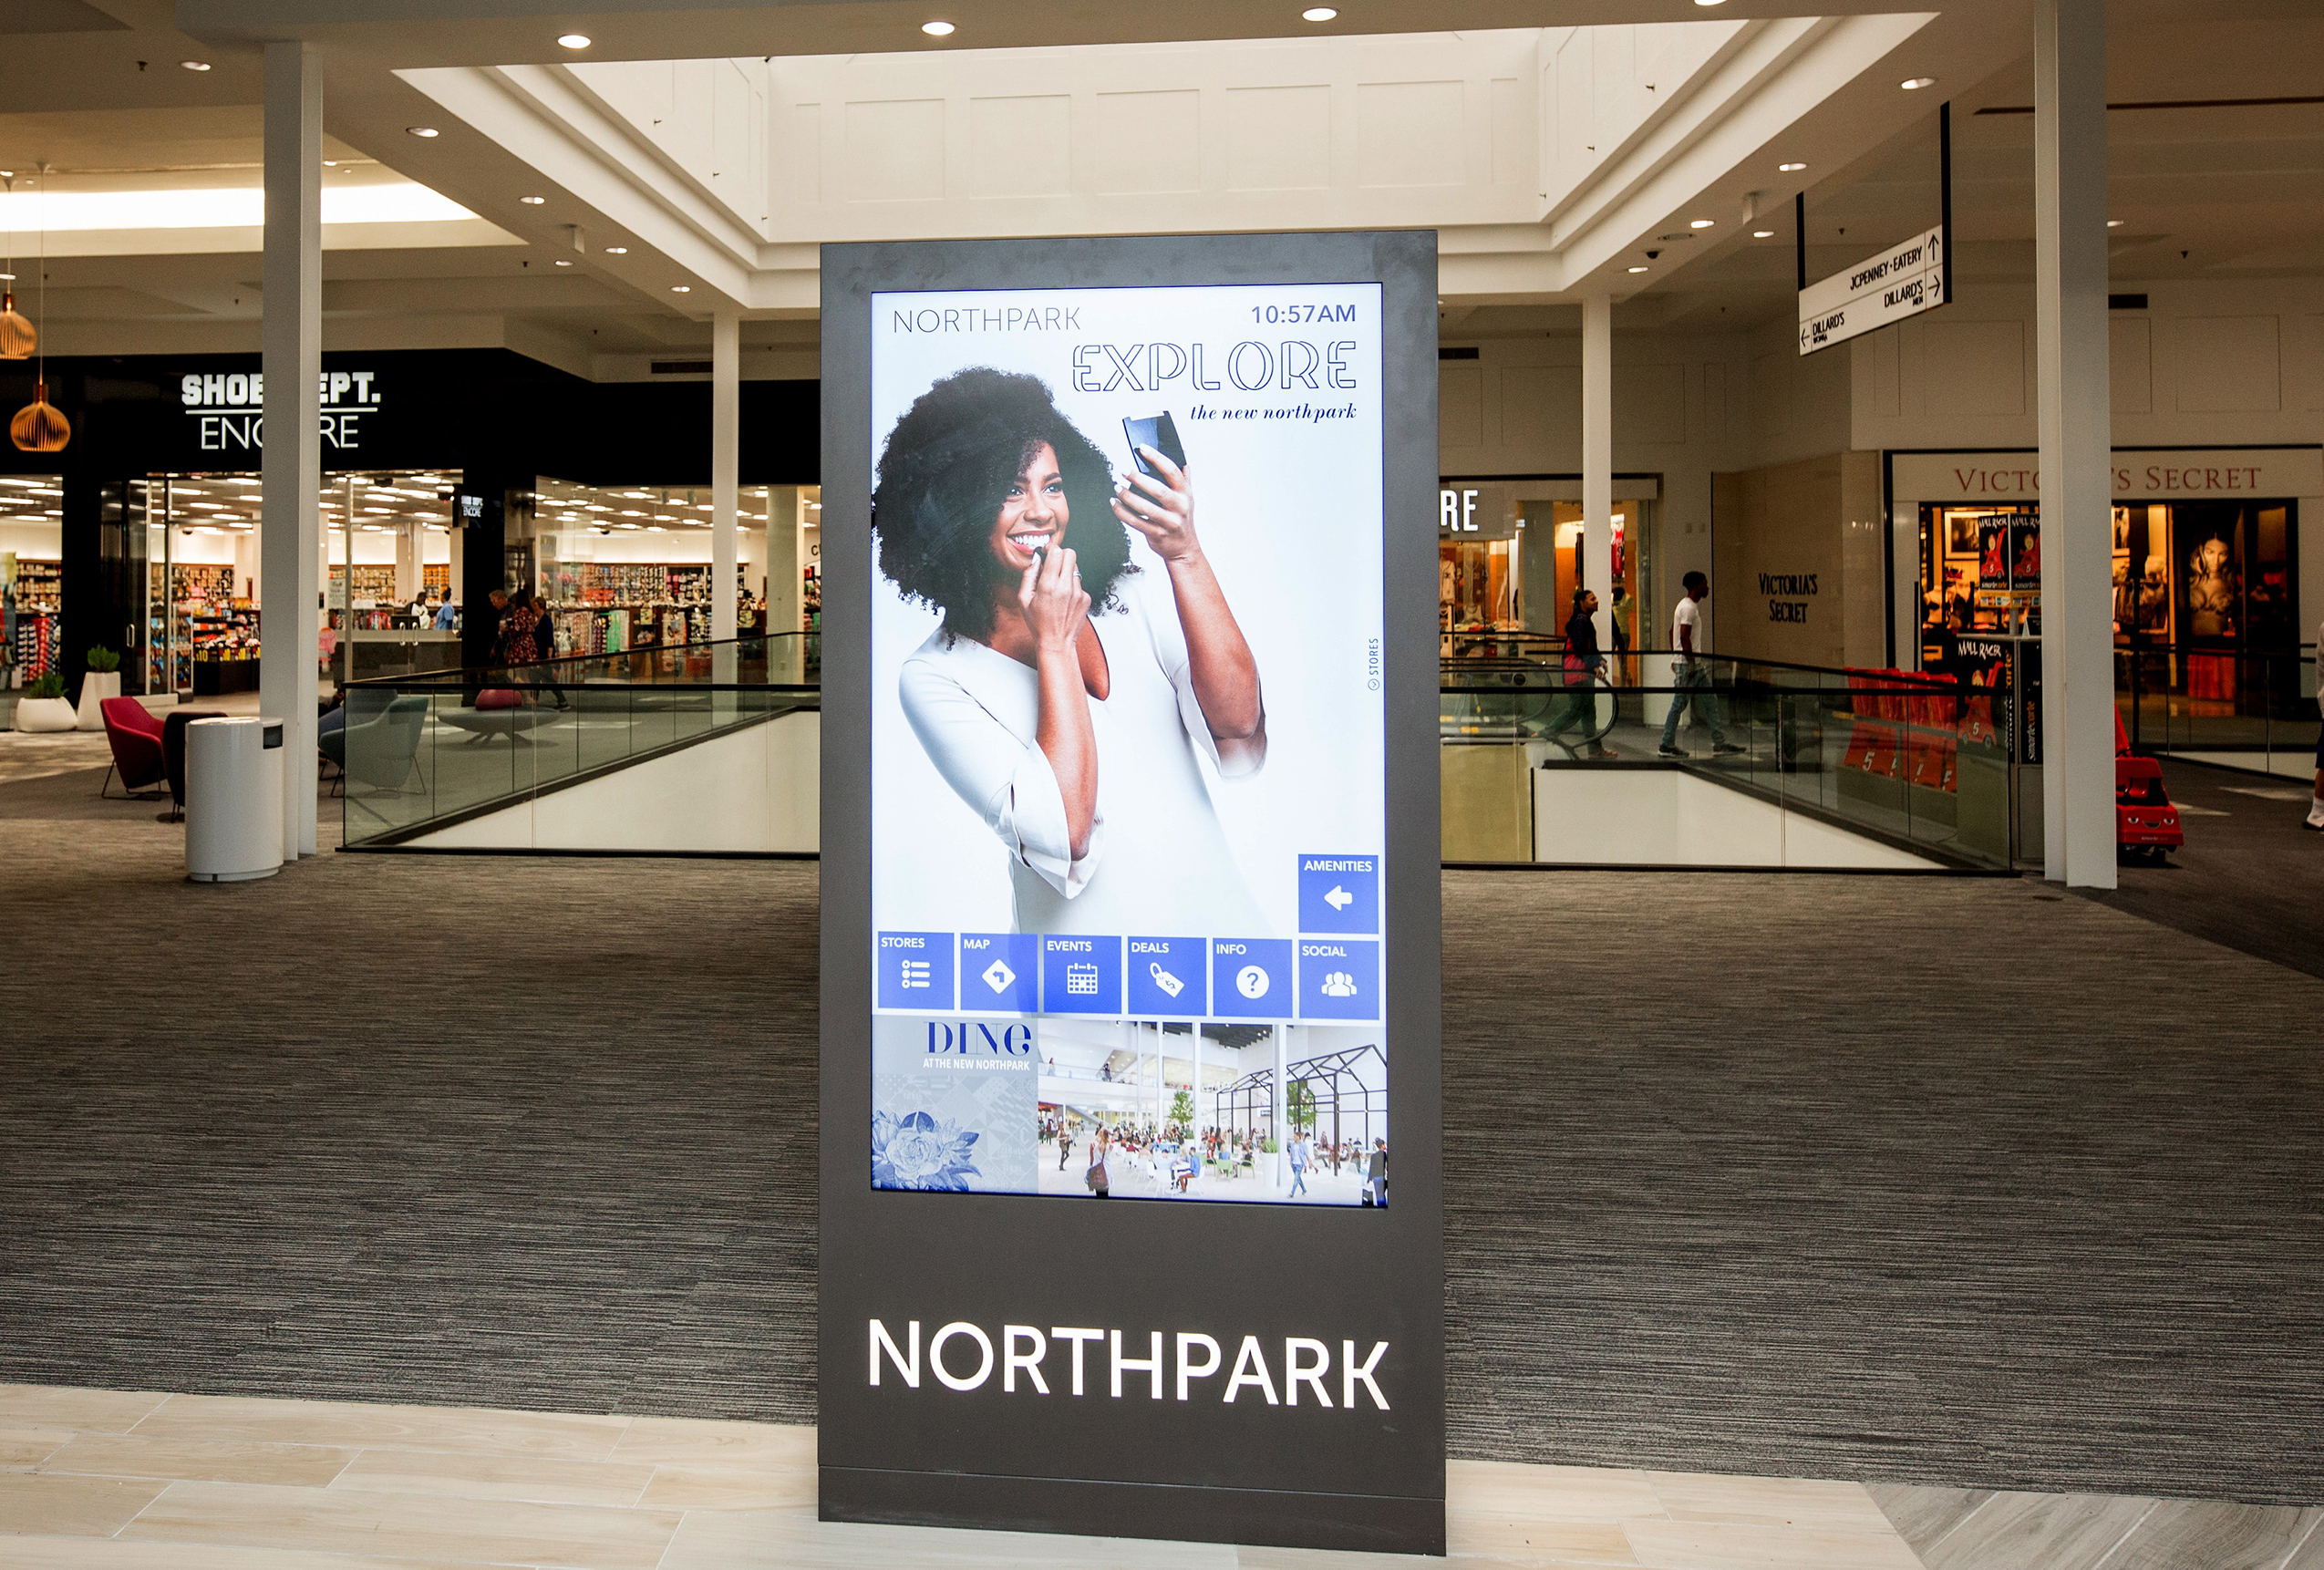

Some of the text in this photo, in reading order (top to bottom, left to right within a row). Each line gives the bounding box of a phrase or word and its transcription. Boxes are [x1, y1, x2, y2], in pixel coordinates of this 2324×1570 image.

[1850, 246, 1922, 291] JCPENNEY EATERY
[1884, 280, 1923, 307] DILLARD'S
[893, 307, 1080, 333] NORTHPARK
[1252, 305, 1356, 324] 10:57AM
[1813, 312, 1844, 336] DILLARD'S
[1073, 341, 1356, 391] EXPLORE
[319, 372, 381, 404] EPT.
[1191, 403, 1357, 423] the new northpark
[2146, 465, 2262, 491] SECRET
[1759, 573, 1817, 594] VICTORIA'S
[1769, 599, 1808, 623] SECRET
[1369, 638, 1379, 675] STORES
[1958, 639, 2002, 660] MALL RACER
[1304, 860, 1373, 873] AMENITIES
[881, 937, 925, 948] STORES
[964, 939, 990, 949] MAP
[1047, 941, 1092, 952] EVENTS
[1131, 943, 1169, 954] DEALS
[1216, 944, 1247, 955] INFO
[1302, 945, 1348, 957] SOCIAL
[923, 1058, 1030, 1071] AT THE NEW NORTHPARK
[869, 1318, 1391, 1411] NORTHPARK
